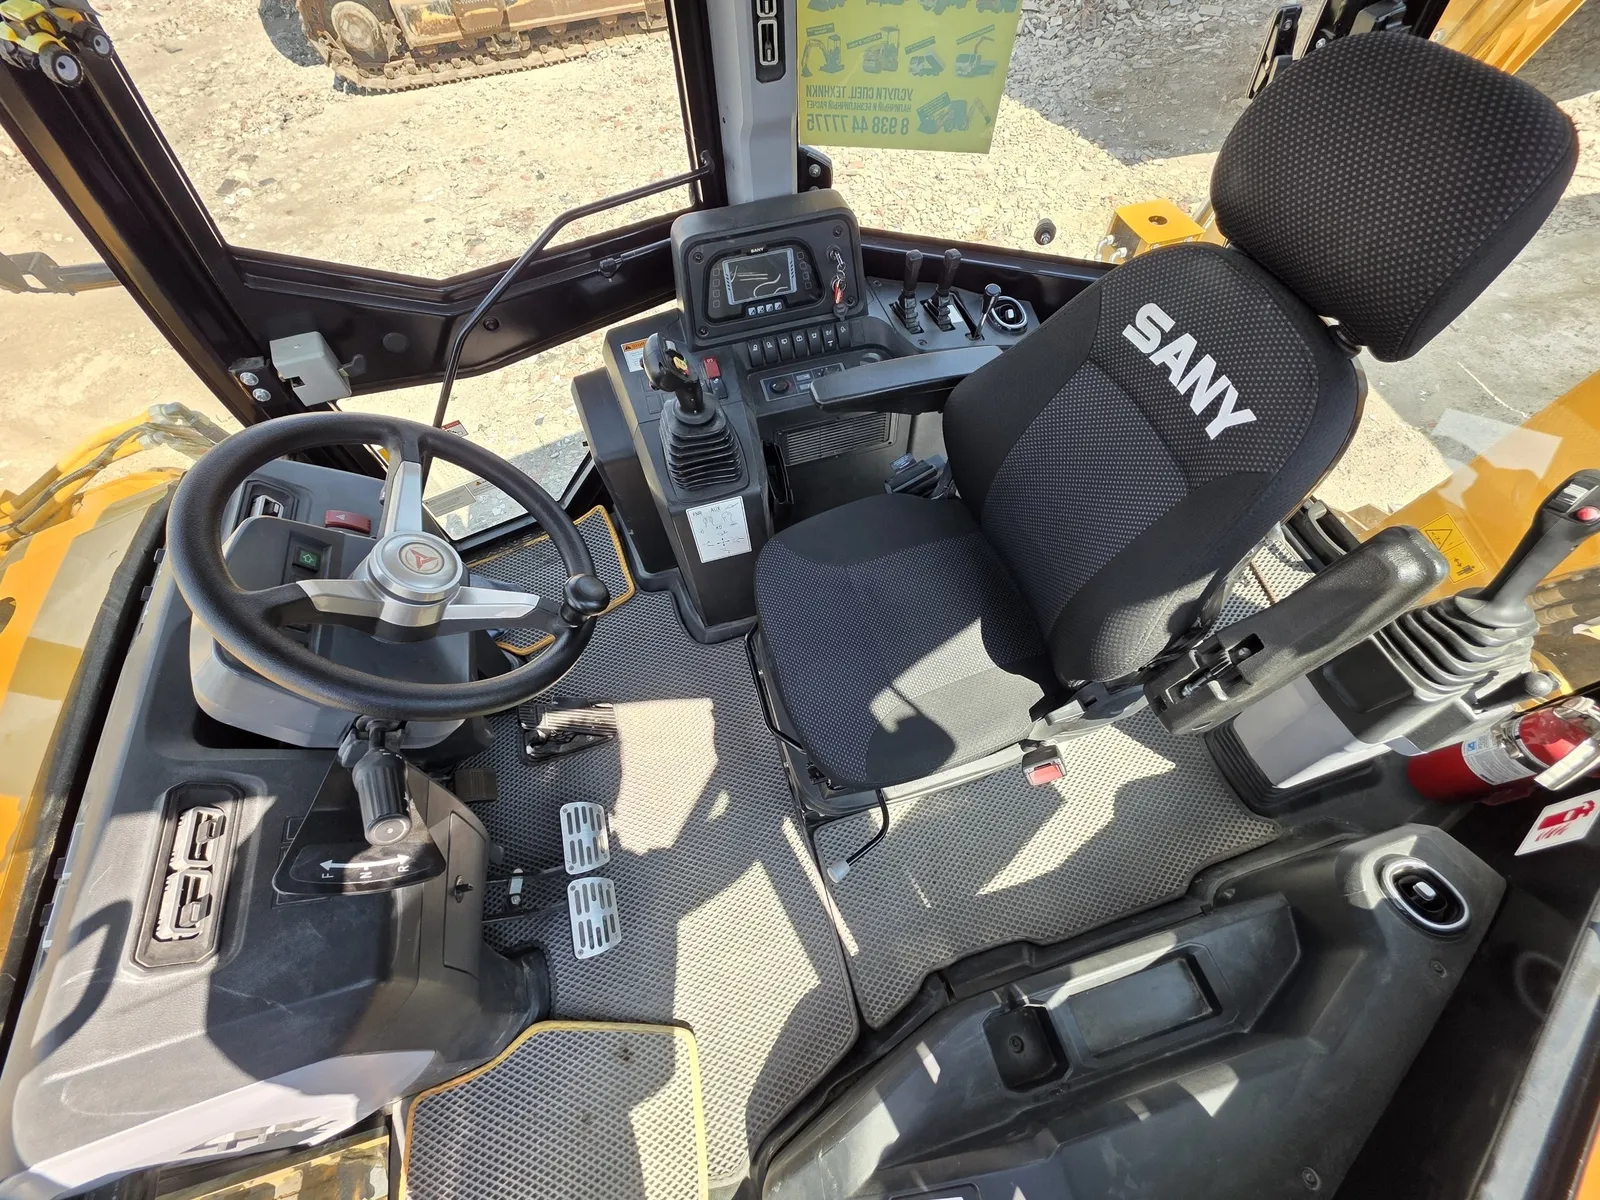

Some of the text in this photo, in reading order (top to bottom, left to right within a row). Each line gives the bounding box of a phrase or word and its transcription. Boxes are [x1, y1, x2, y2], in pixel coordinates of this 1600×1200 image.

[1122, 303, 1257, 440] SANY
[359, 871, 372, 879] N
[397, 864, 410, 873] R
